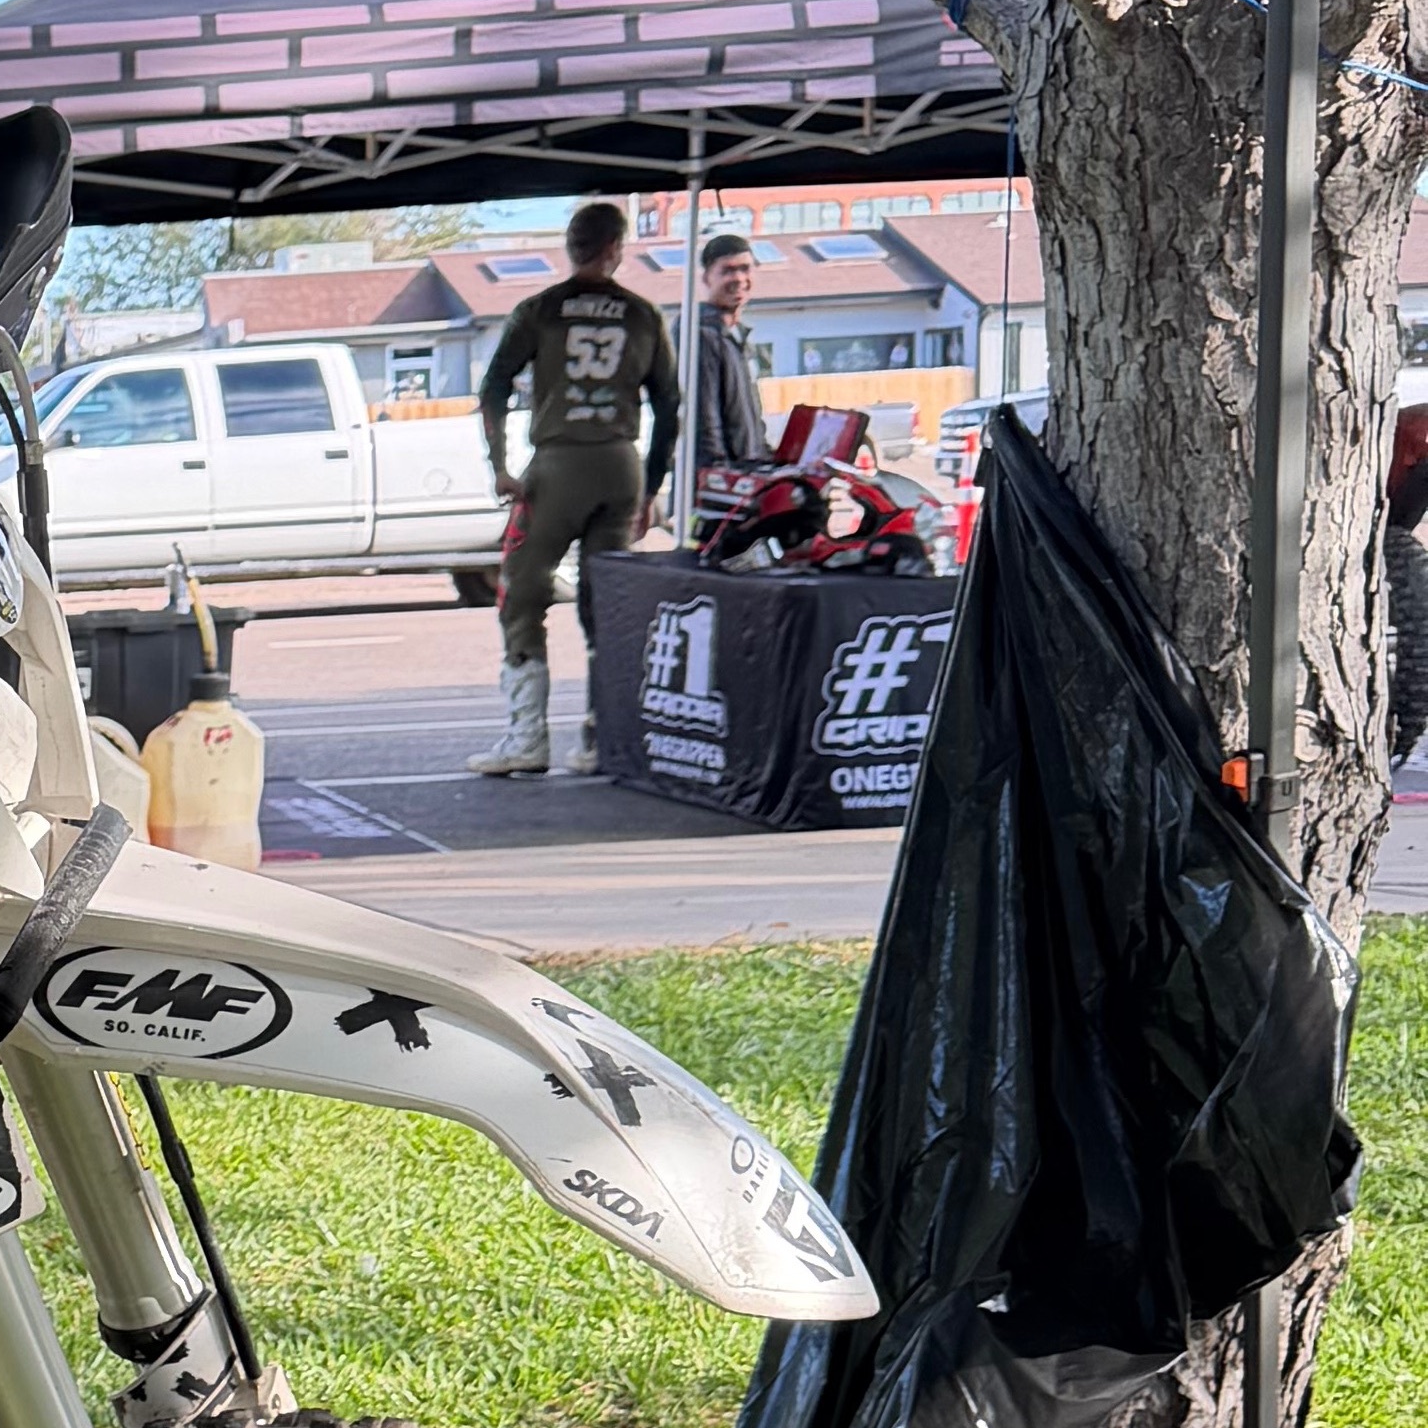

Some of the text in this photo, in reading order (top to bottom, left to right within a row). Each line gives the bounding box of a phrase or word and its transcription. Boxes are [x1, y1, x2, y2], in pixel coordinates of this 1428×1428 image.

[565, 325, 627, 380] 53
[647, 605, 713, 698] #1
[55, 968, 267, 1023] FMF
[104, 1019, 207, 1043] SO. CALIF.
